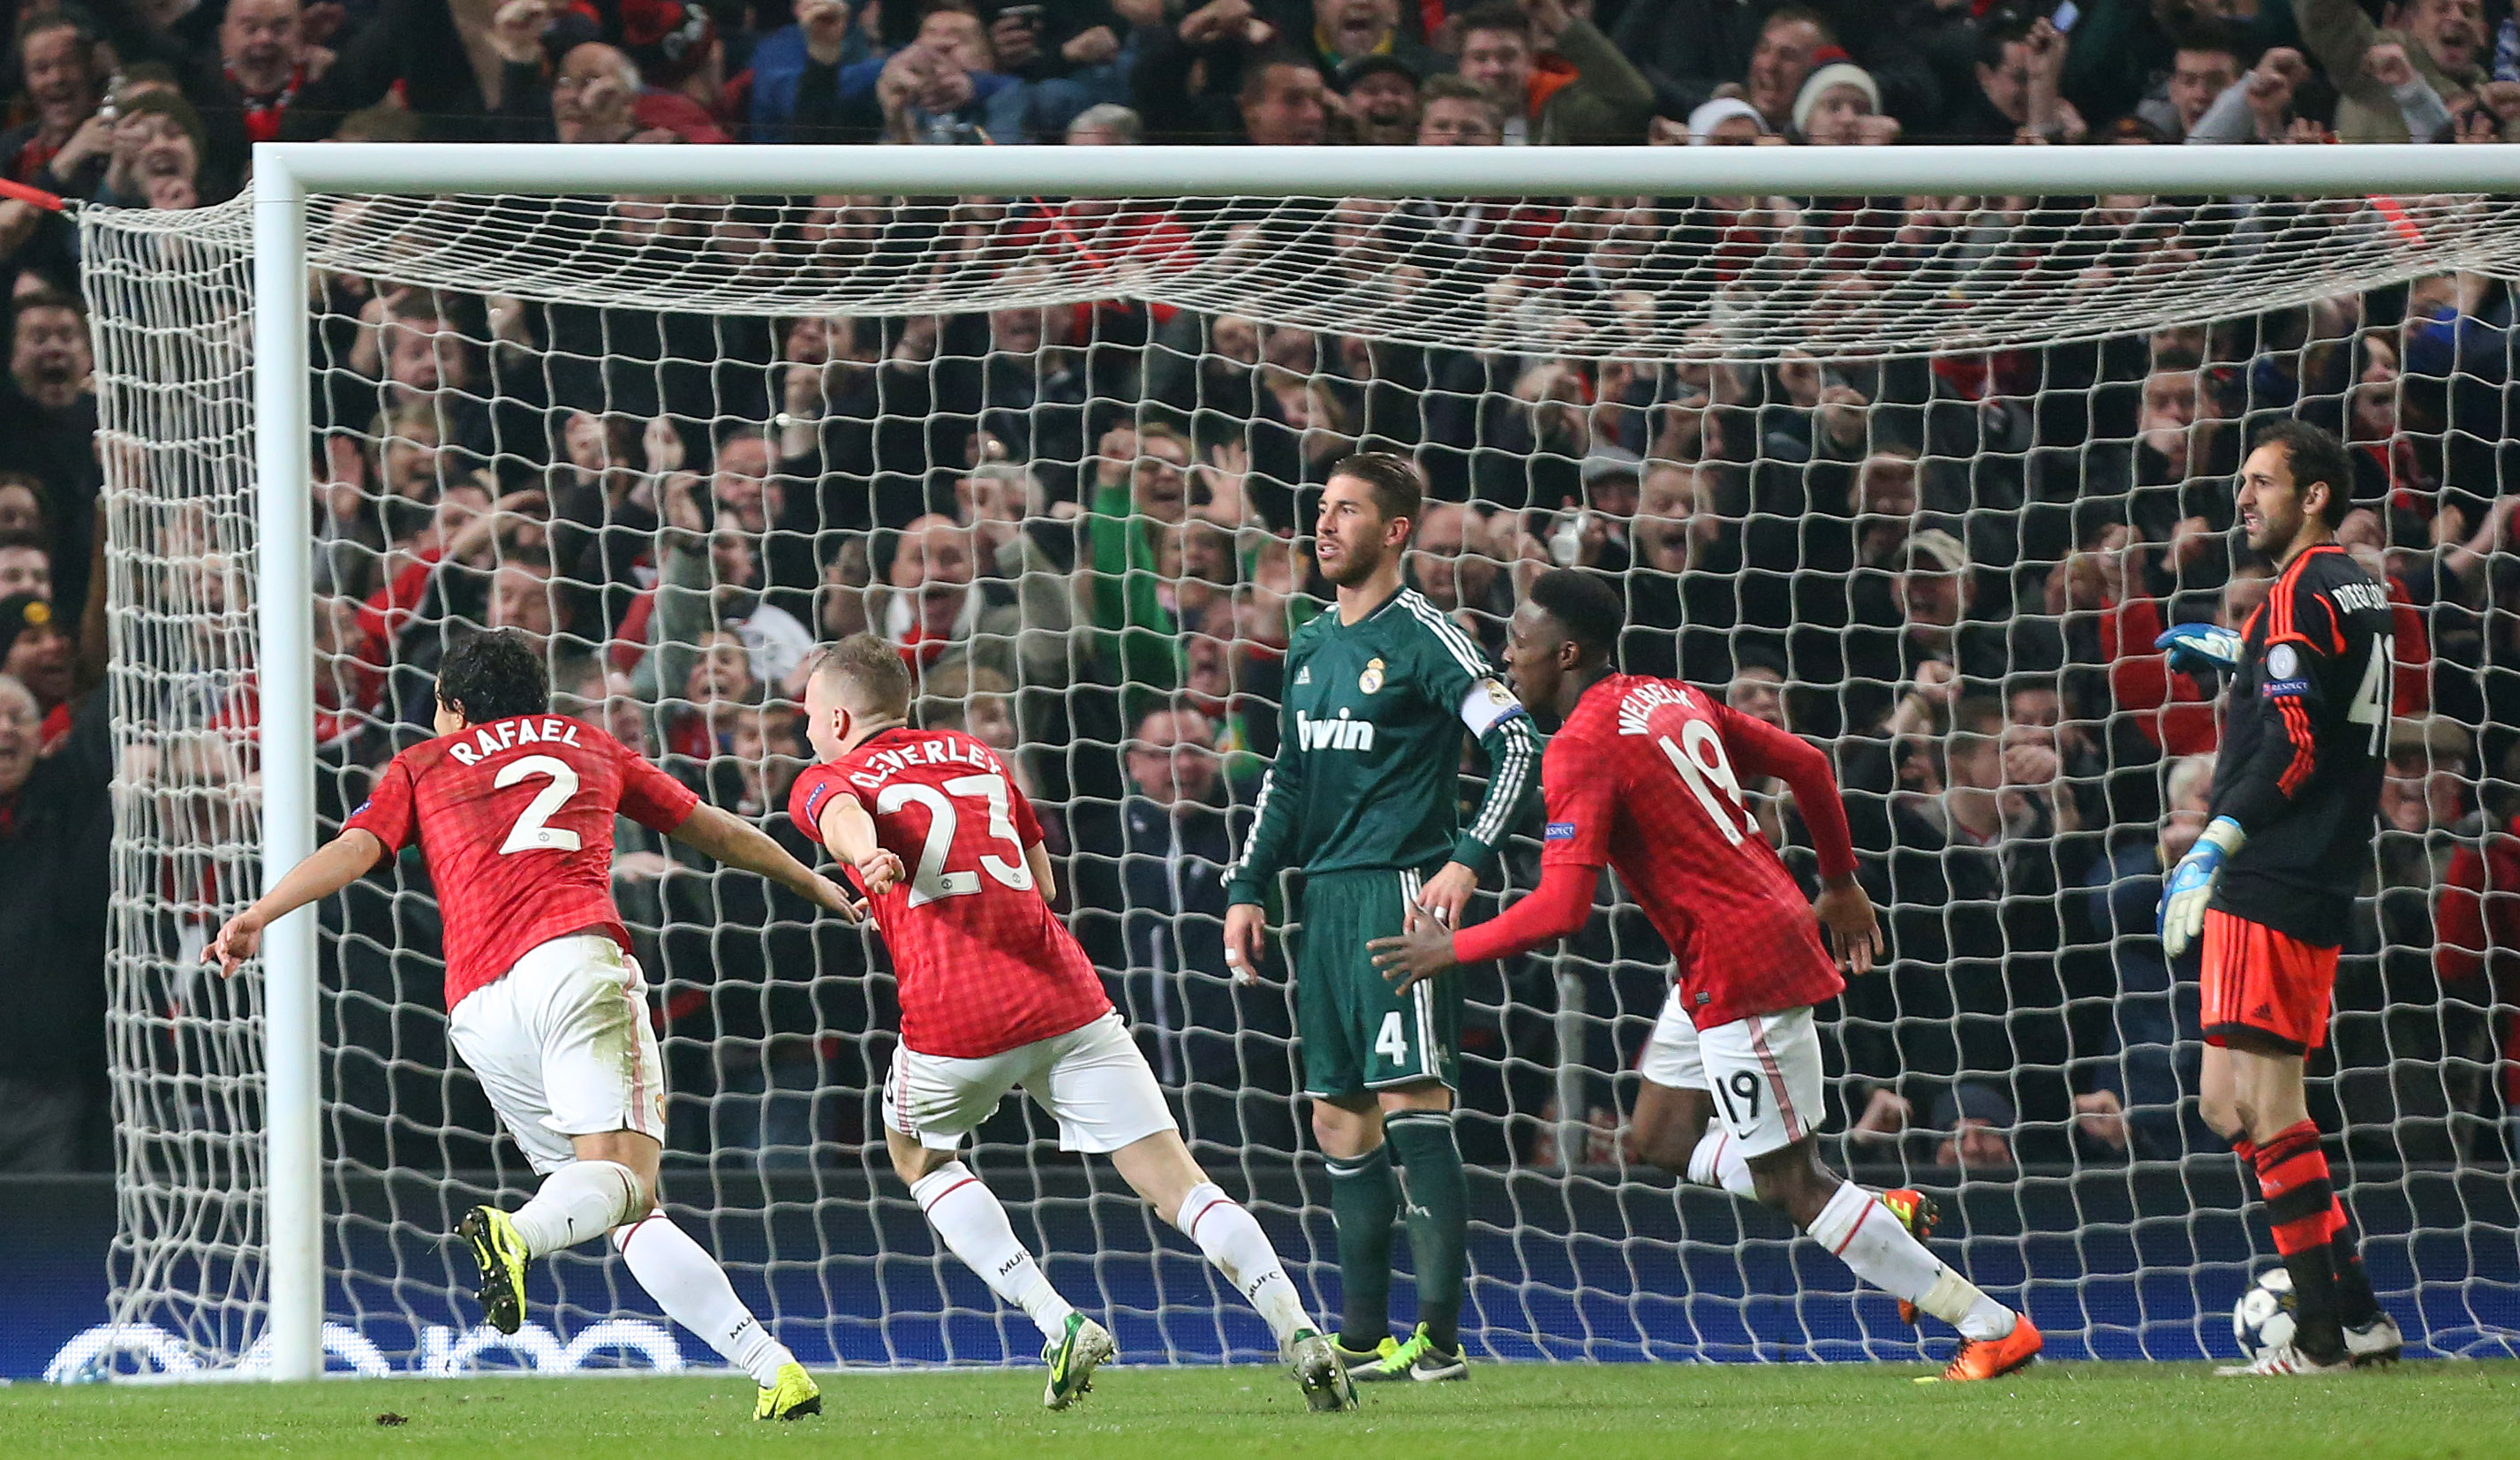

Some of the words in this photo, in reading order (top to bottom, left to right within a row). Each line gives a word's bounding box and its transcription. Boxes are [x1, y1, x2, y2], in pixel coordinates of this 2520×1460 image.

[1296, 707, 1375, 753] bwin
[1618, 683, 1697, 736] WELBECK
[449, 719, 581, 766] RAFAEL
[849, 737, 1002, 789] CLEVERLEY
[494, 754, 582, 855] 2
[1657, 718, 1761, 847] 19
[877, 773, 1032, 909] 23
[1375, 1010, 1408, 1067] 4
[1715, 1070, 1760, 1124] 19
[1249, 1271, 1280, 1301] MUFC
